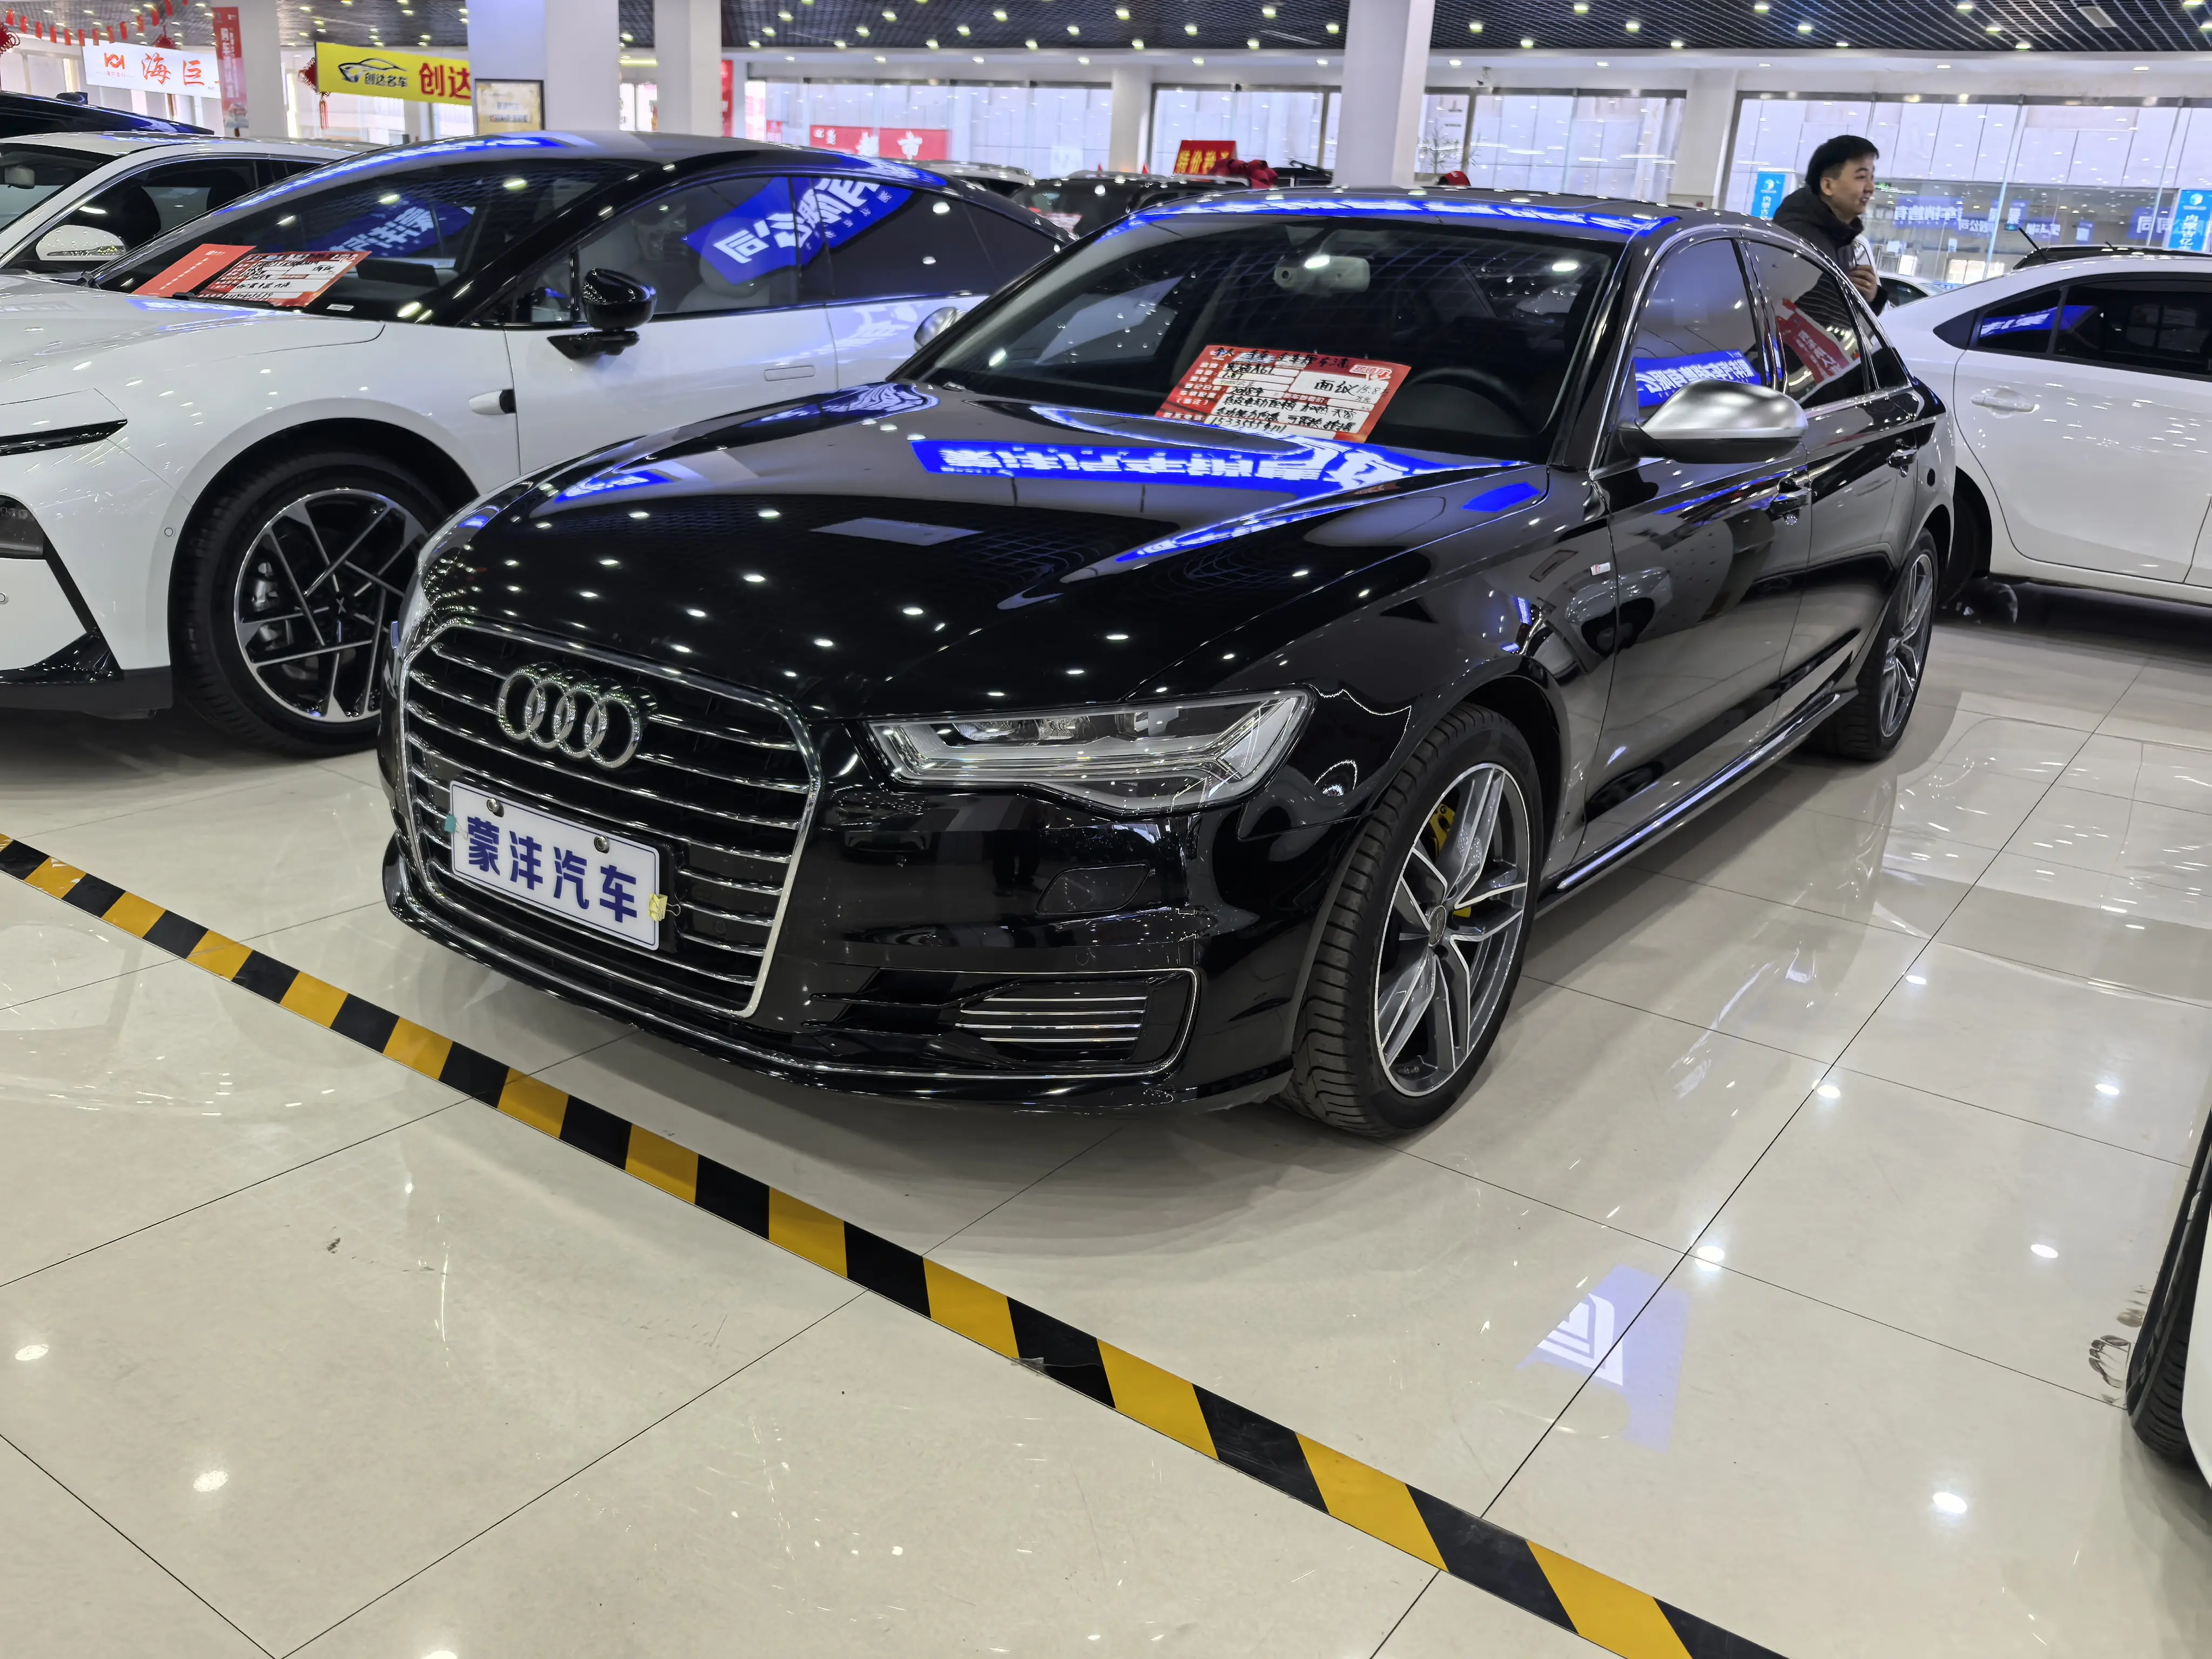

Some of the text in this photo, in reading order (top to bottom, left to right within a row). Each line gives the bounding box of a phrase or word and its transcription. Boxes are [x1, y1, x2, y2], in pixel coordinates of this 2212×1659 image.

[365, 72, 408, 87] 创达名车
[419, 63, 471, 100] 创达
[1314, 379, 1358, 396] 面议
[467, 815, 637, 923] 蒙沣汽车
